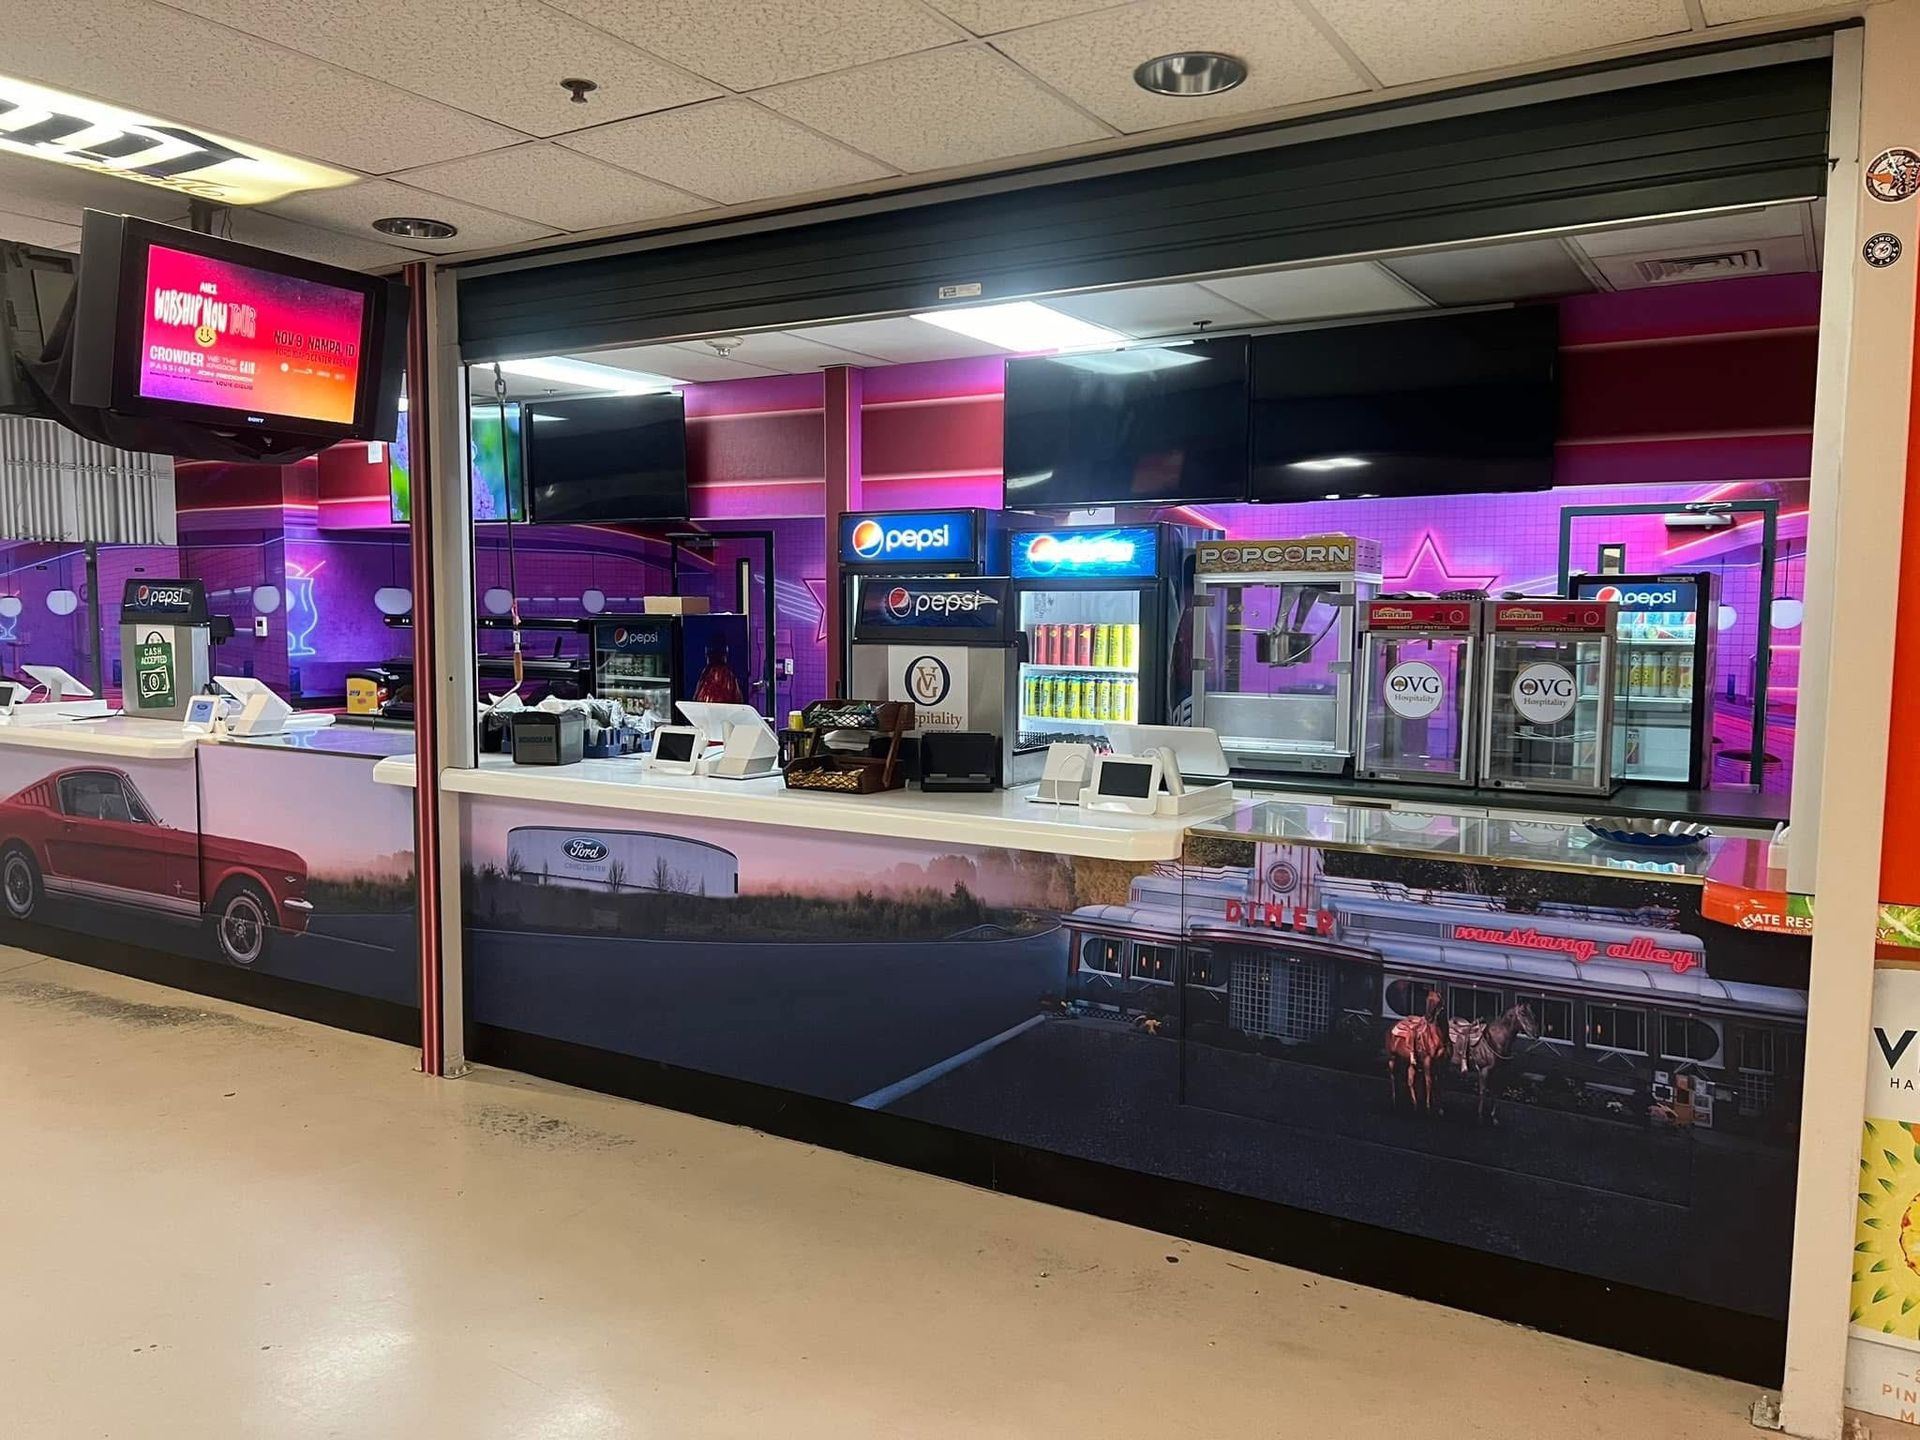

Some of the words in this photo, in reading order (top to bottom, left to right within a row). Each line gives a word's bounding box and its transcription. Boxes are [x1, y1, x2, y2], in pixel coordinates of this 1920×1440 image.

[154, 288, 202, 328] WORSHIP
[202, 297, 228, 333] NOW
[229, 302, 257, 338] TOUR
[274, 329, 294, 346] NOV
[296, 335, 303, 347] 9
[346, 343, 355, 357] ID
[149, 345, 205, 367] CROWDER
[149, 362, 191, 373] PASSION
[886, 524, 949, 552] pepsi
[1201, 545, 1350, 564] POPCORN
[150, 588, 183, 606] pepsi
[915, 589, 980, 617] pepsi
[1373, 609, 1412, 619] Bavarian
[1500, 610, 1542, 620] Bavarian
[629, 631, 658, 645] pepsi
[140, 655, 168, 665] ACCEPTED
[143, 647, 162, 656] CASH
[1391, 675, 1440, 693] OVG
[1520, 678, 1572, 697] OVG
[1394, 694, 1436, 704] Hospitality
[1523, 697, 1568, 708] Hospitality
[914, 711, 962, 729] spitality
[570, 840, 599, 858] Ford
[1225, 899, 1335, 939] DINER
[1455, 927, 1599, 963] mustang
[1606, 937, 1697, 973] alley
